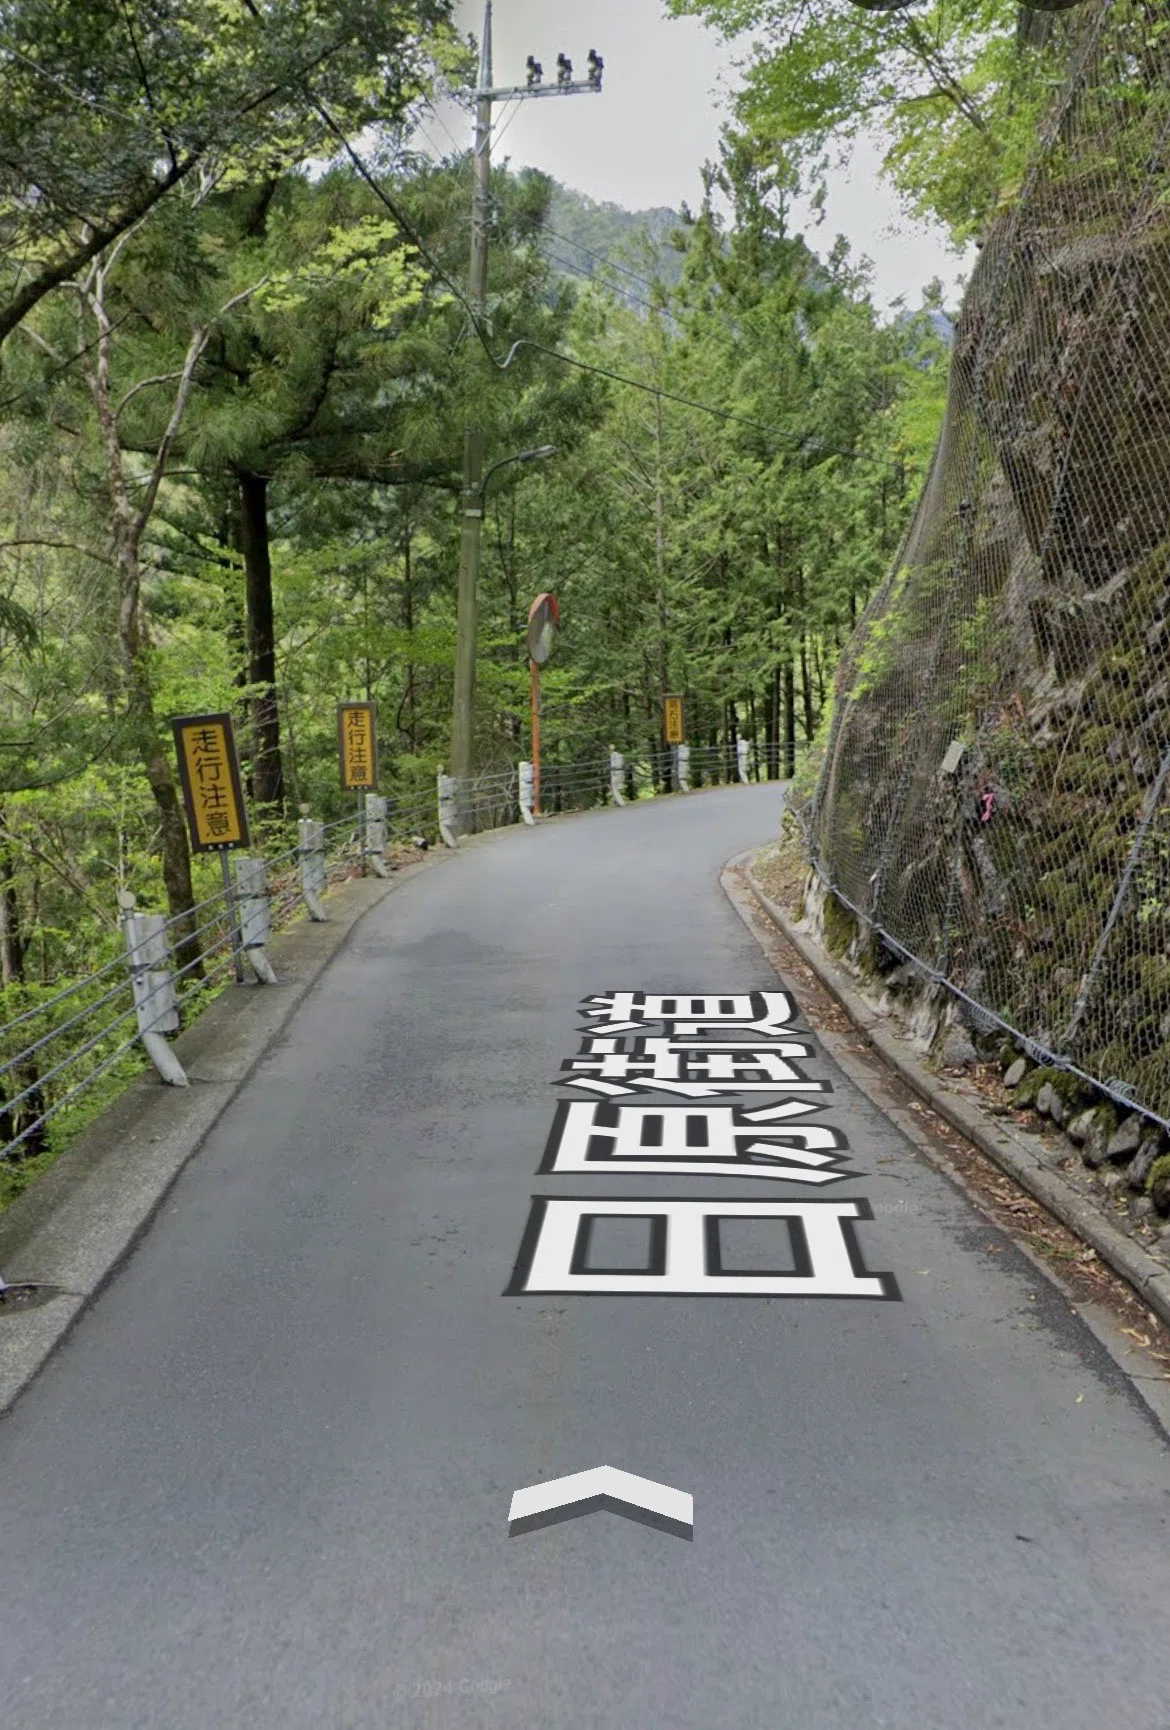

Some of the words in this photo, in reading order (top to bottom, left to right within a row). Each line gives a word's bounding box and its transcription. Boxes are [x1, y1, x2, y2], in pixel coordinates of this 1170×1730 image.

[191, 729, 231, 838] 走行注意
[347, 710, 368, 782] 走行注意
